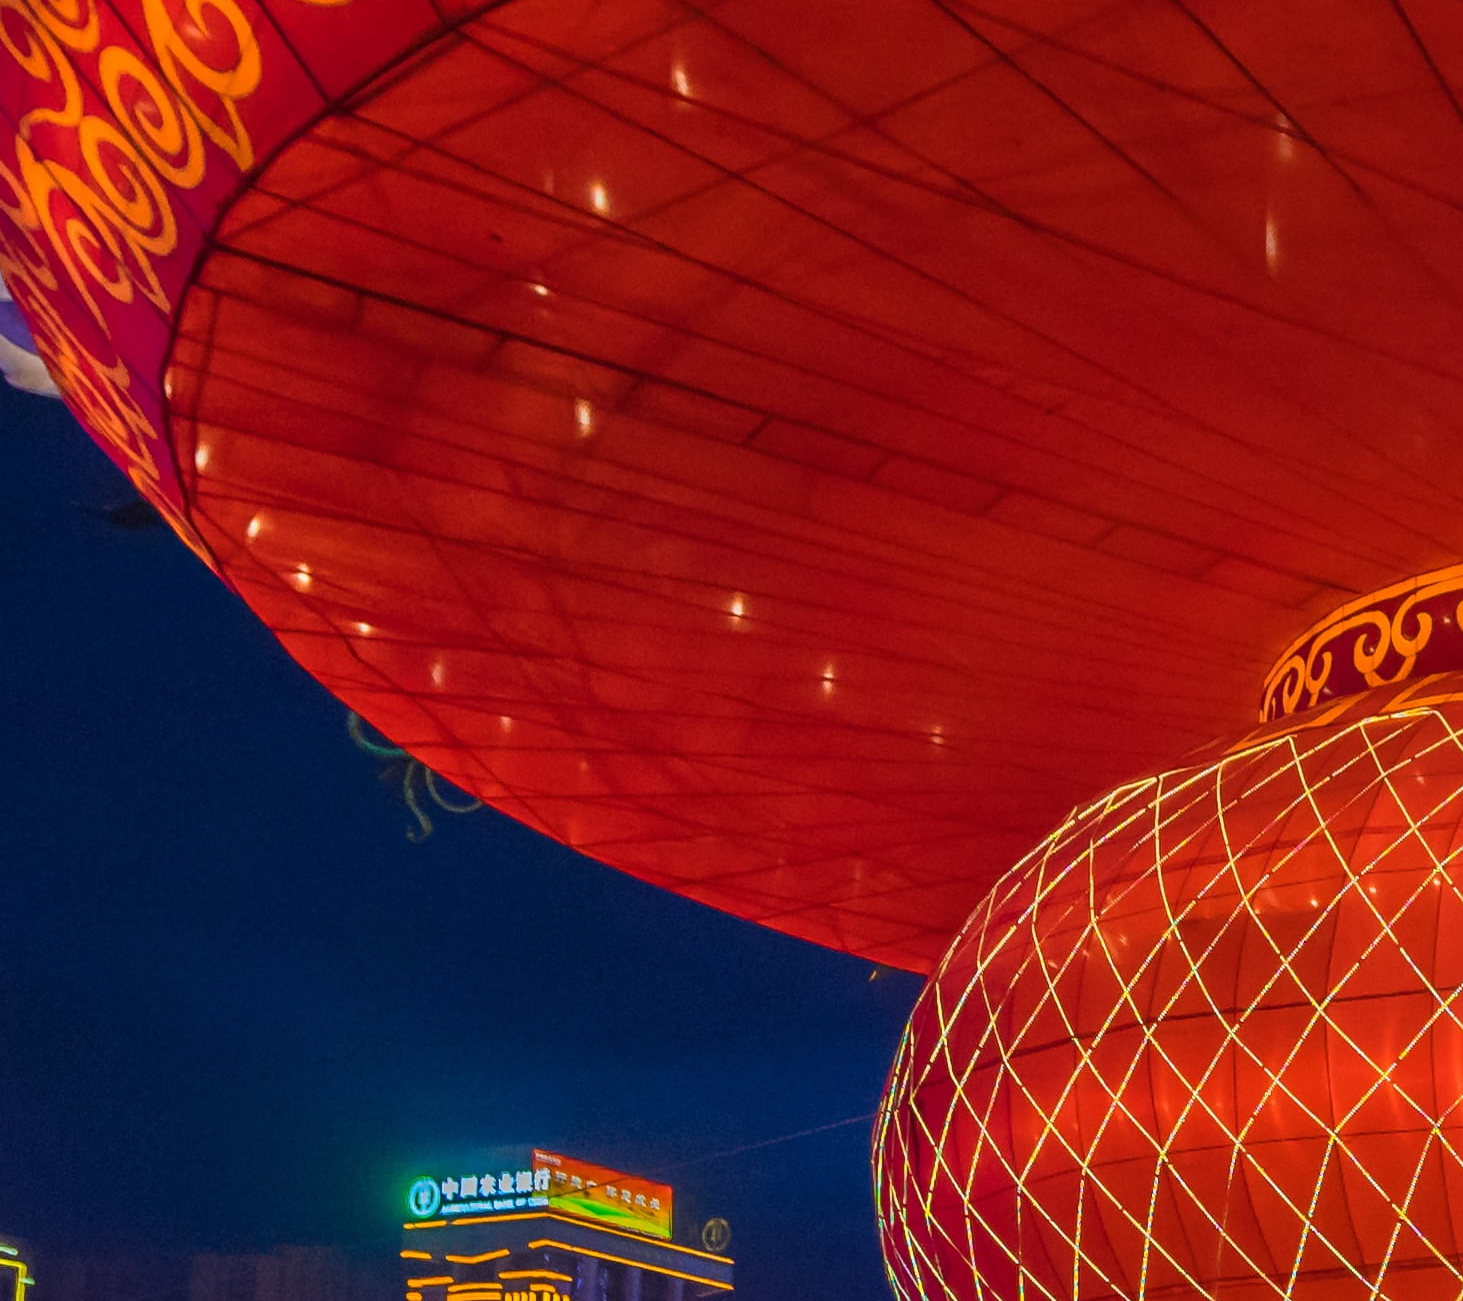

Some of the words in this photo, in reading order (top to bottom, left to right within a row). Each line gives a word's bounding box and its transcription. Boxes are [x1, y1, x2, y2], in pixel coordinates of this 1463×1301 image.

[440, 1167, 551, 1200] 中国农业银行
